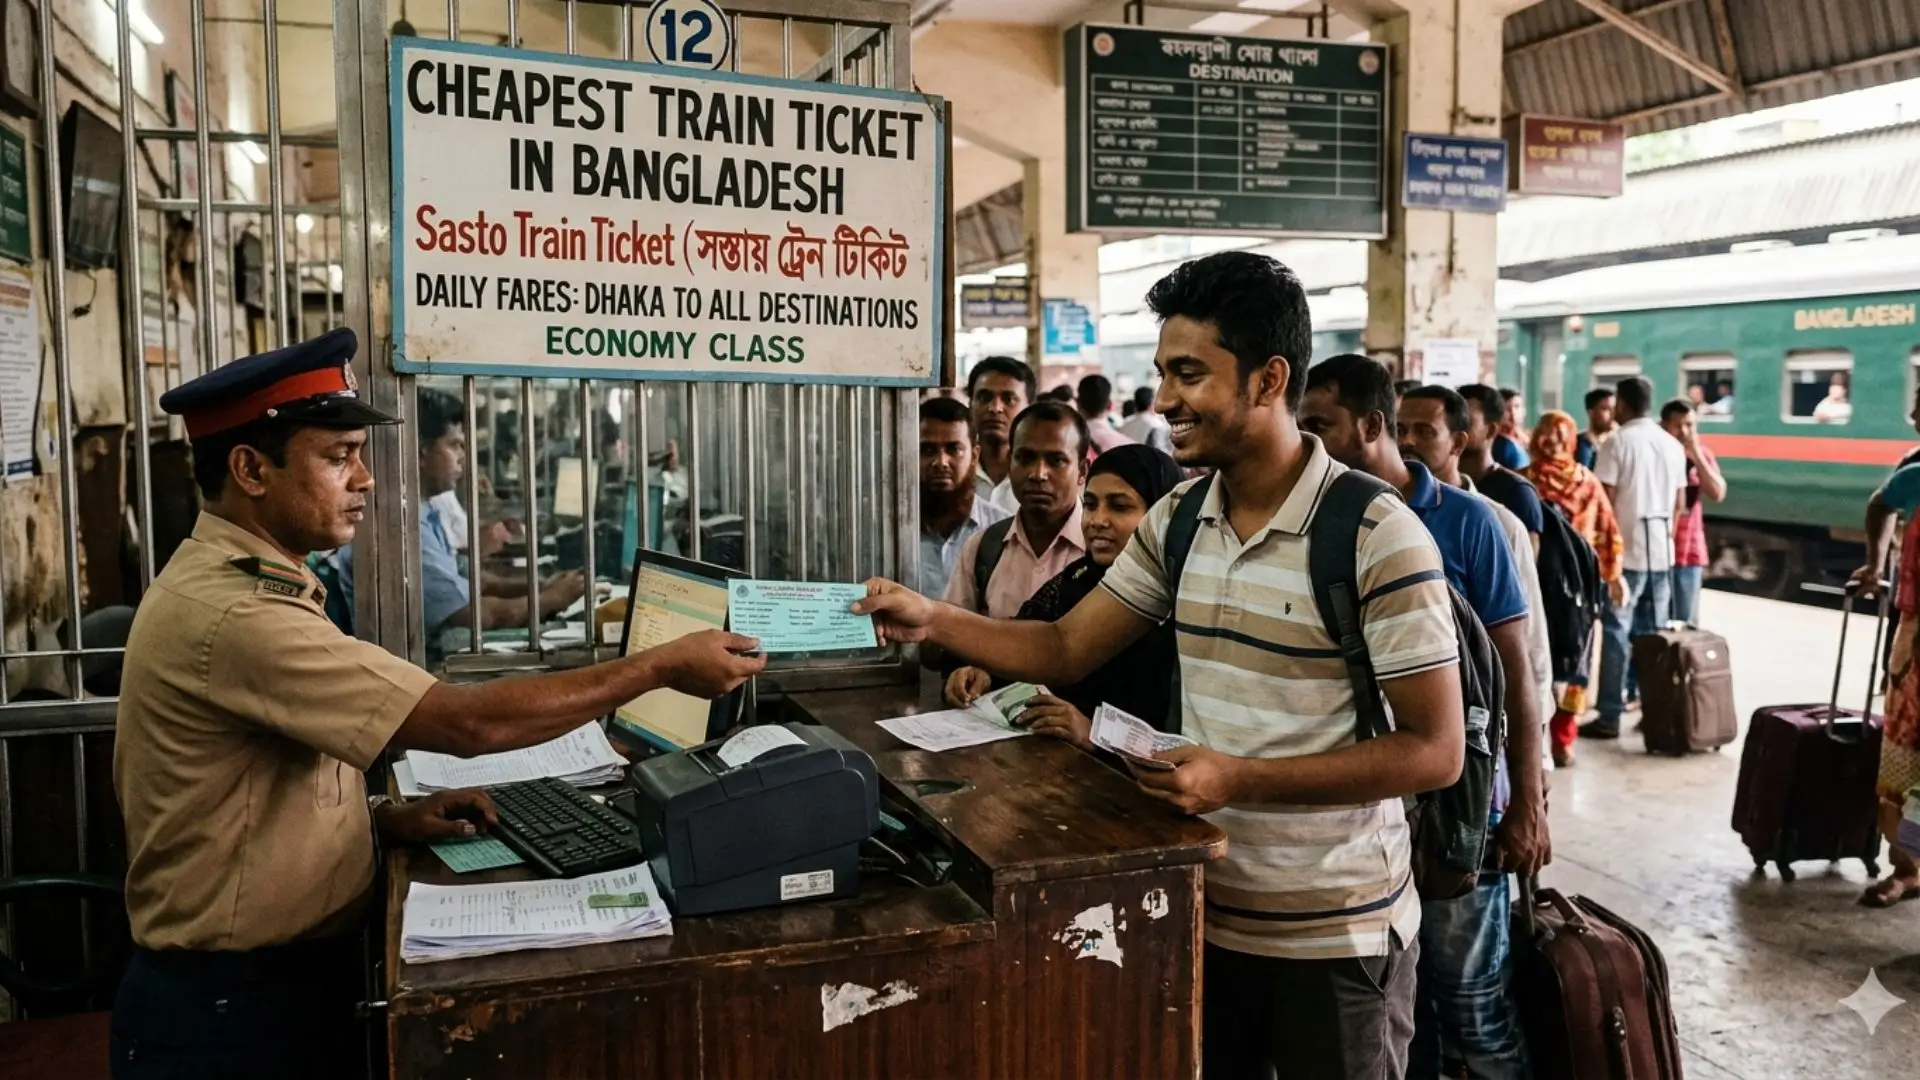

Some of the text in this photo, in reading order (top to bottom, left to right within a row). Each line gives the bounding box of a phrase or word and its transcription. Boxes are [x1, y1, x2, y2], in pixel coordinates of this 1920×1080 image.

[660, 9, 713, 64] 12
[1188, 63, 1294, 84] DESTINATION
[407, 59, 923, 161] CHEAPEST TRAIN TICKET
[510, 137, 844, 215] IN BANGLADESH
[415, 204, 507, 256] Sasto
[513, 210, 586, 261] Train
[591, 216, 675, 267] Ticket
[777, 220, 827, 282] ট্রেন
[832, 223, 910, 281] টিকিট
[416, 272, 919, 330] DAILY FARES: DHAKA TO ALL DESTINATIONS
[1794, 303, 1917, 331] BANGLADESH
[546, 326, 805, 363] ECONOMY CLASS
